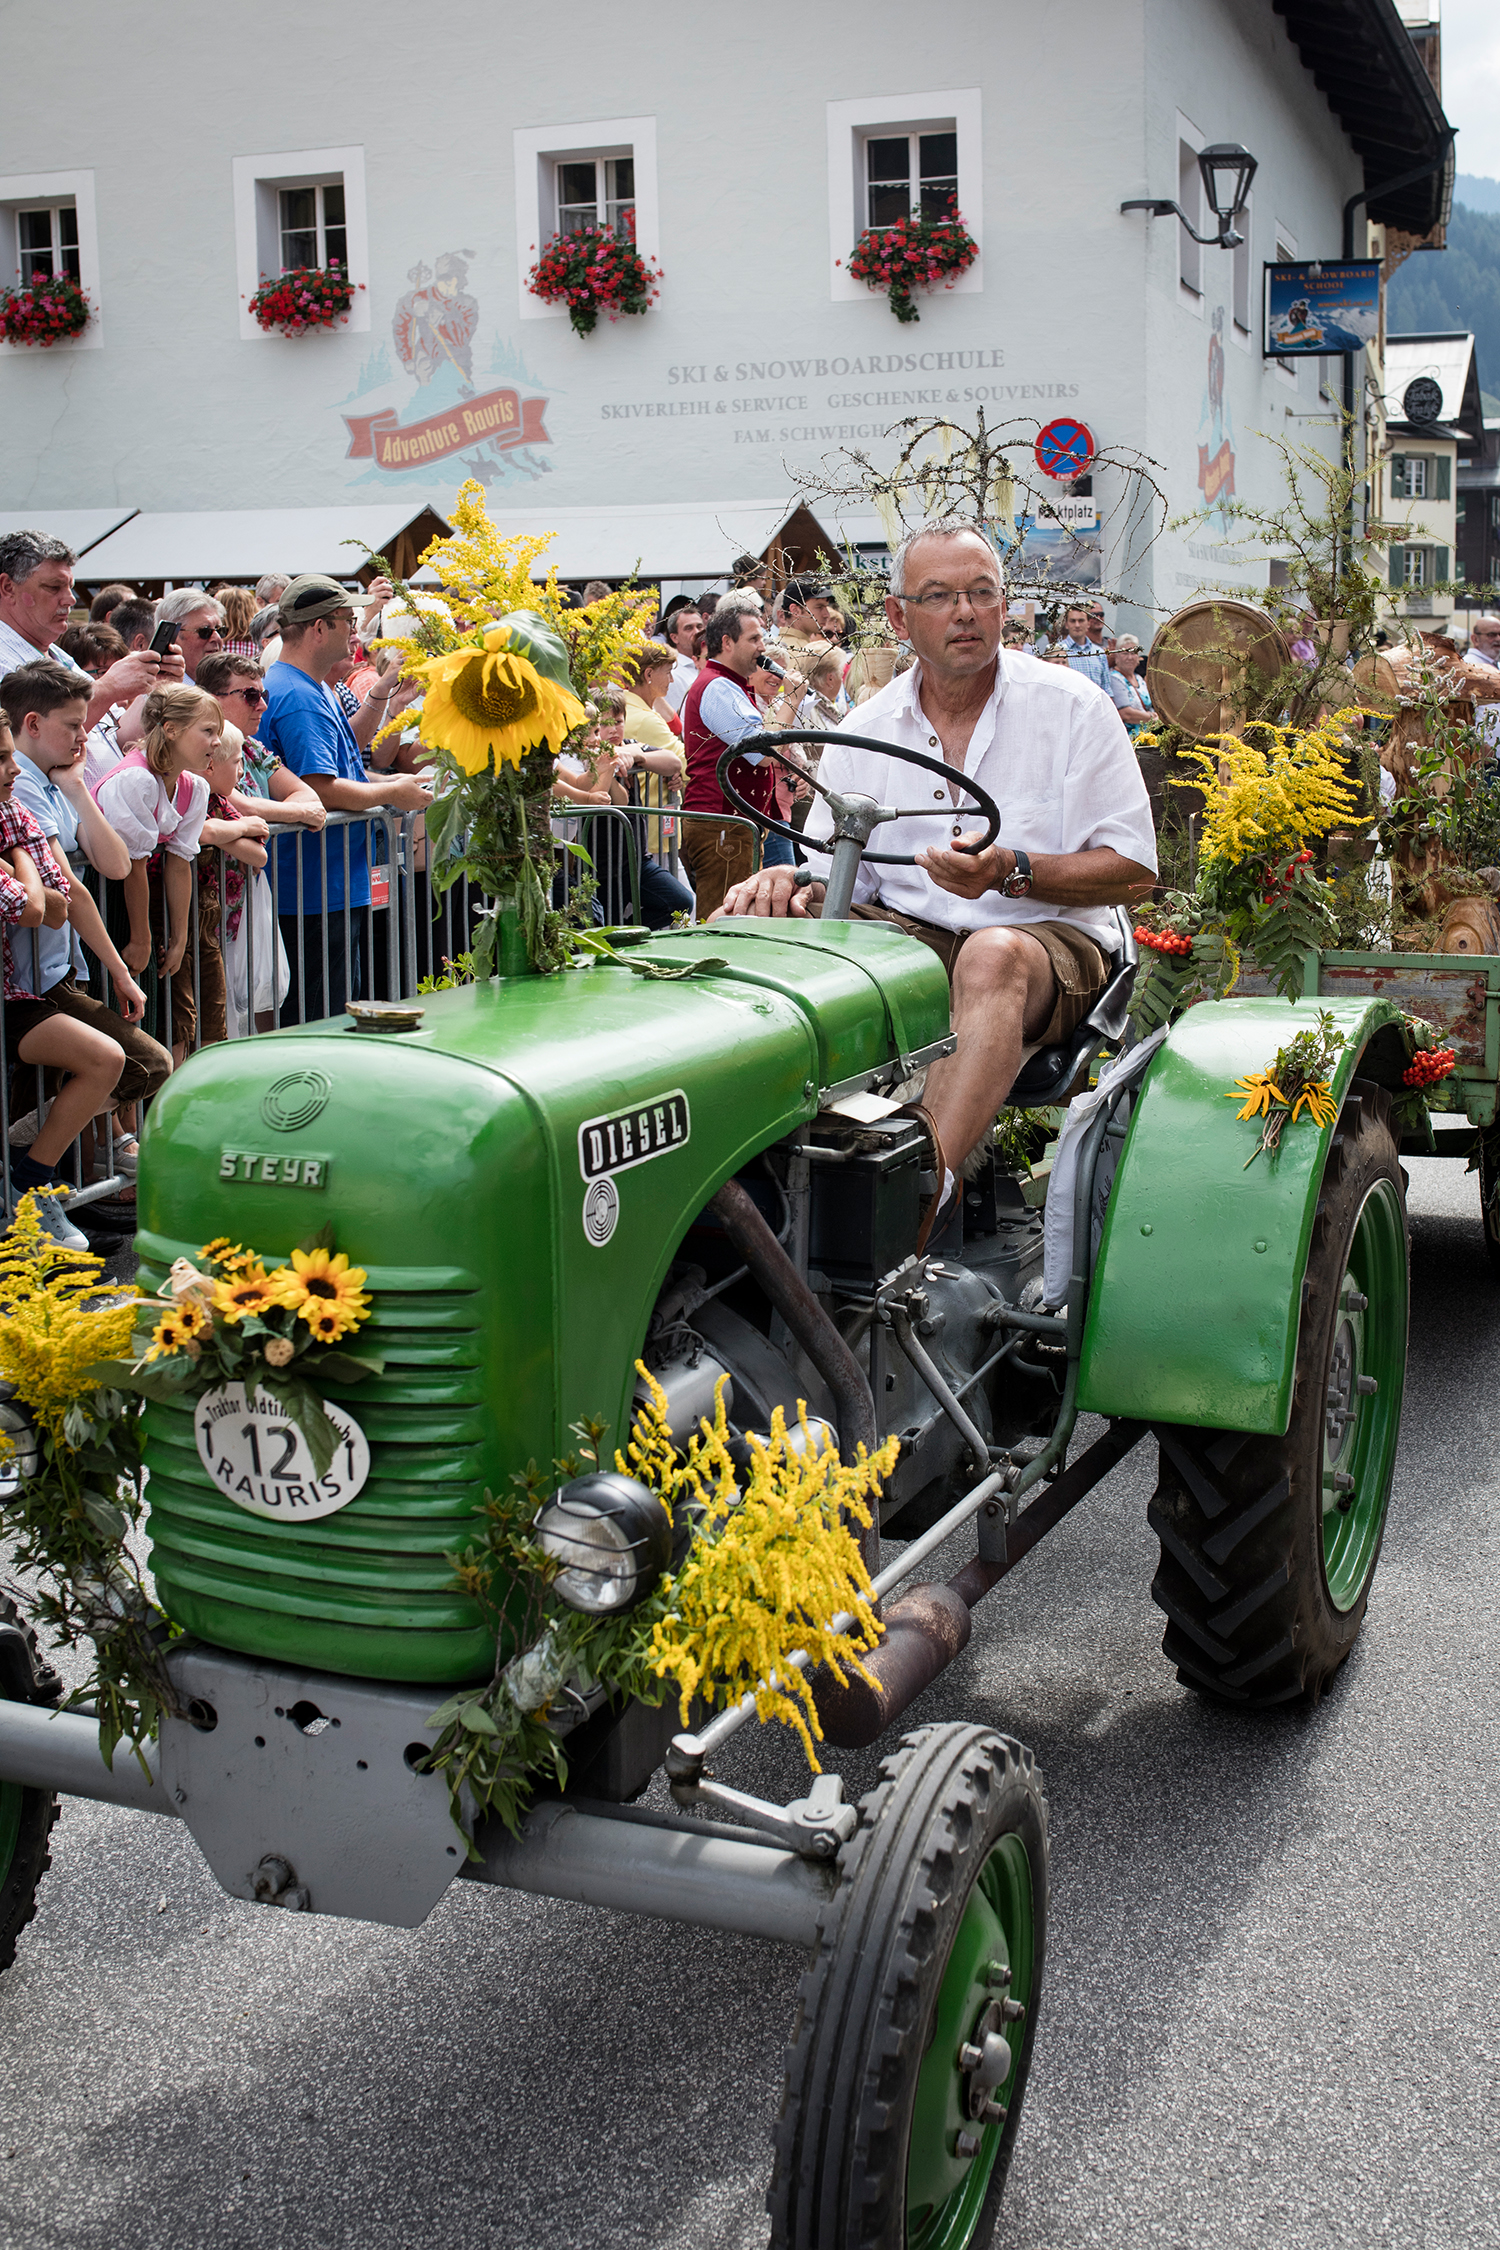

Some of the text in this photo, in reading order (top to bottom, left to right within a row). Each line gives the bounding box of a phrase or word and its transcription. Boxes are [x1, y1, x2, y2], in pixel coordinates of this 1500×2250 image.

[1298, 273, 1306, 281] &
[1303, 281, 1345, 290] SCHOOL
[667, 349, 1006, 386] SKI & SNOWBOARDSCHULE
[600, 395, 809, 421] SKIVERLEIH & SERVICE
[827, 383, 1080, 409] GESCHENKE & SOUVENIRS
[381, 398, 515, 463] Adventure Rauris
[733, 428, 776, 444] FAM.
[1038, 504, 1093, 522] Mktplatz
[588, 1101, 683, 1172] DIESEL
[219, 1153, 322, 1186] STEYR
[205, 1397, 242, 1423] Traktor
[241, 1422, 302, 1482] 12
[216, 1455, 342, 1508] RAURIS
